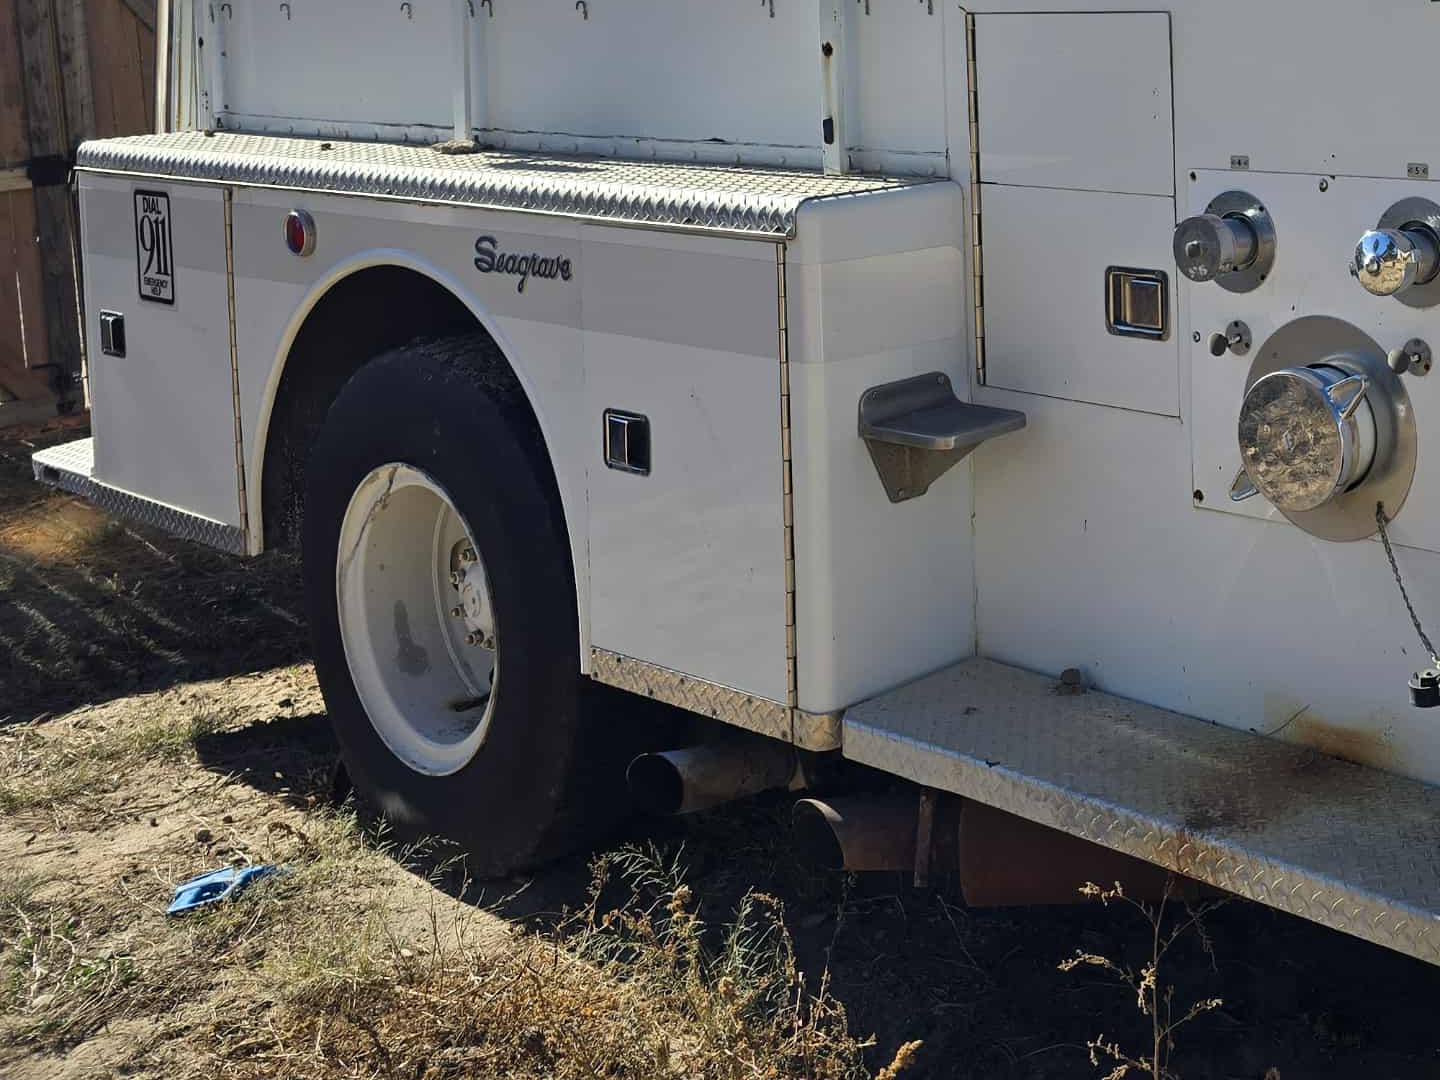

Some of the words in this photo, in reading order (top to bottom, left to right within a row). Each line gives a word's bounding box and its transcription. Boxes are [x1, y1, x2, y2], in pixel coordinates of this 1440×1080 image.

[142, 197, 162, 215] DIAL
[140, 214, 171, 276] 911
[474, 235, 572, 293] Seagrave
